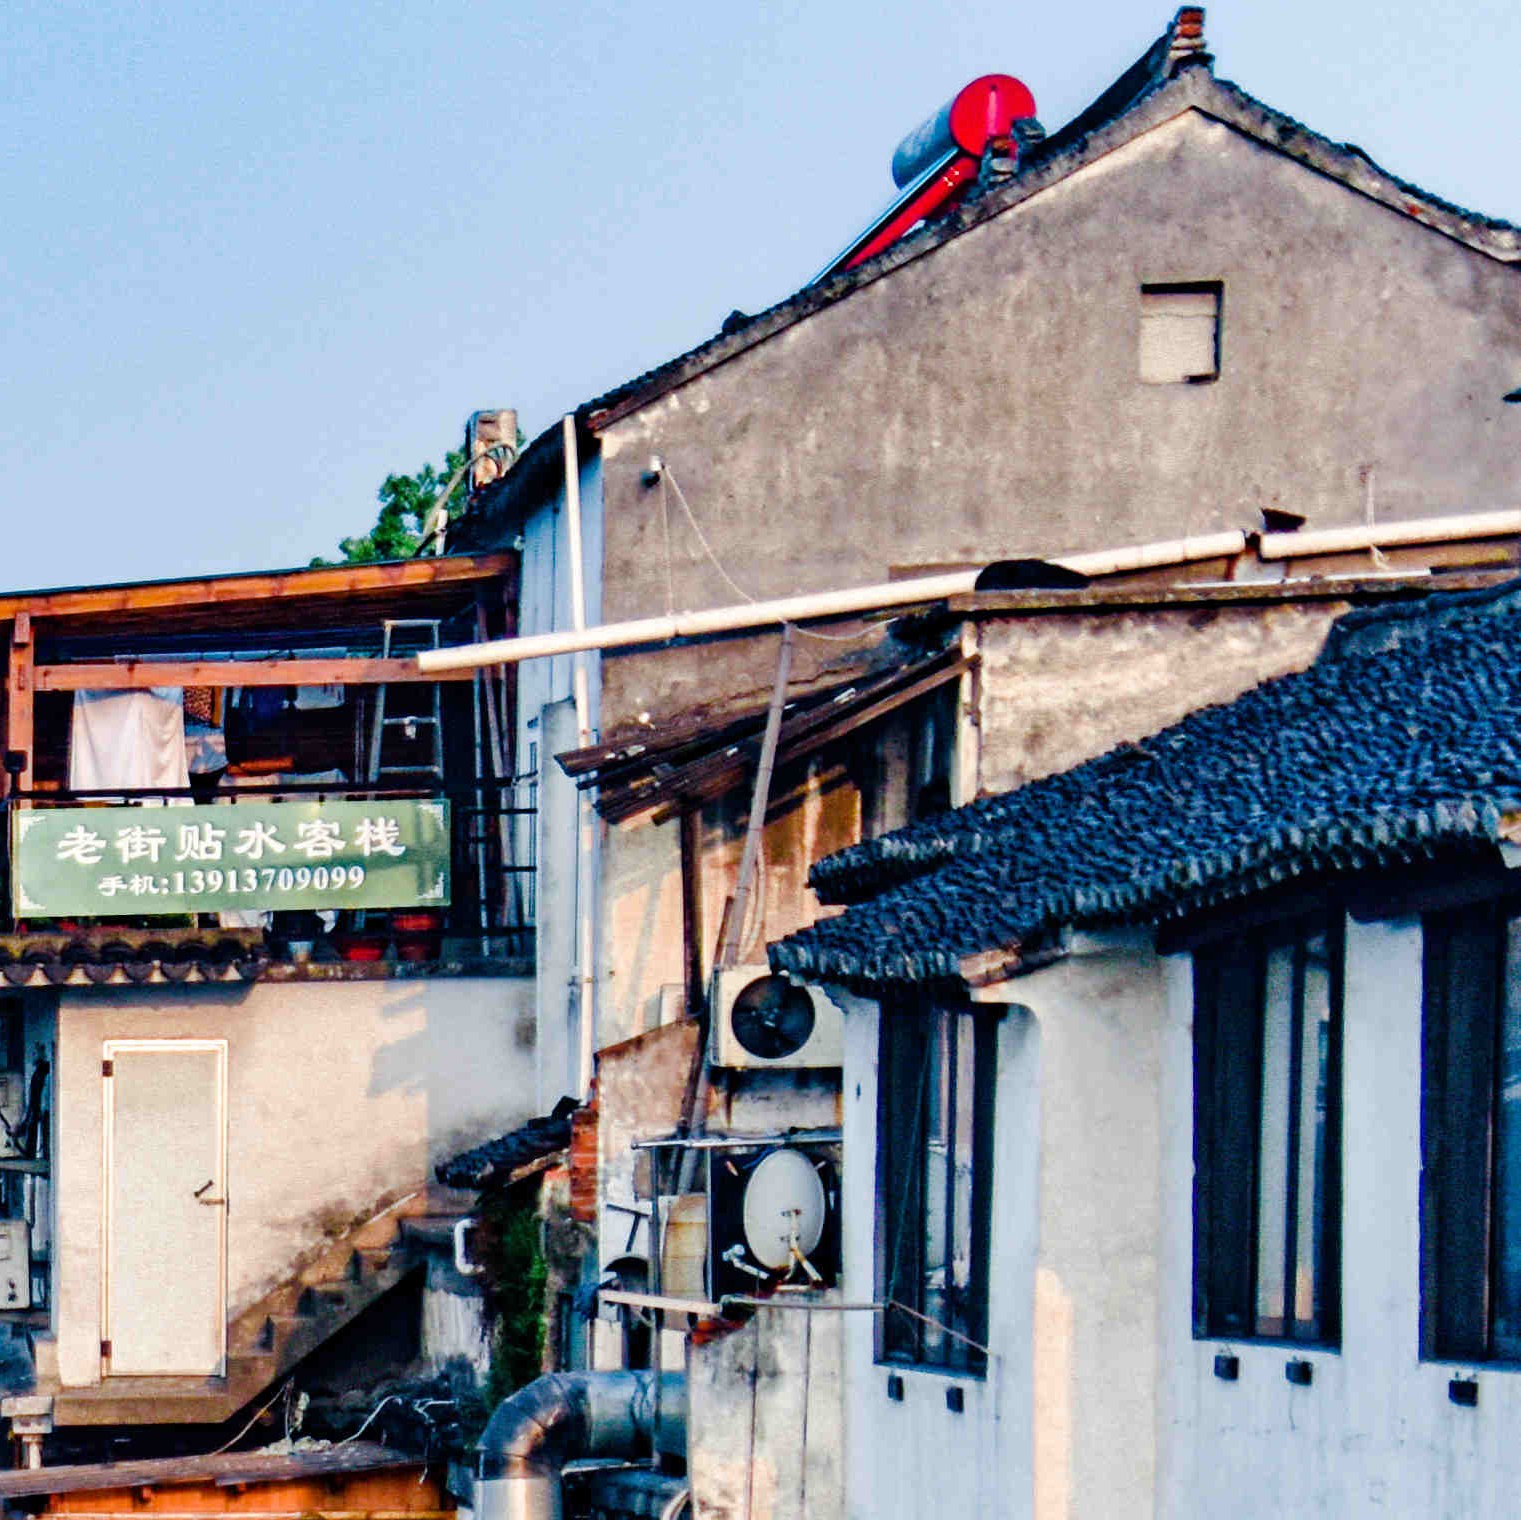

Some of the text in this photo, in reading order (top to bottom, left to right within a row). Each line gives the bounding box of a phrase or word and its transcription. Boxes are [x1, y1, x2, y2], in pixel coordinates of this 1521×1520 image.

[56, 815, 407, 864] 老街贴水客栈
[97, 864, 367, 898] 手机:13913709099
